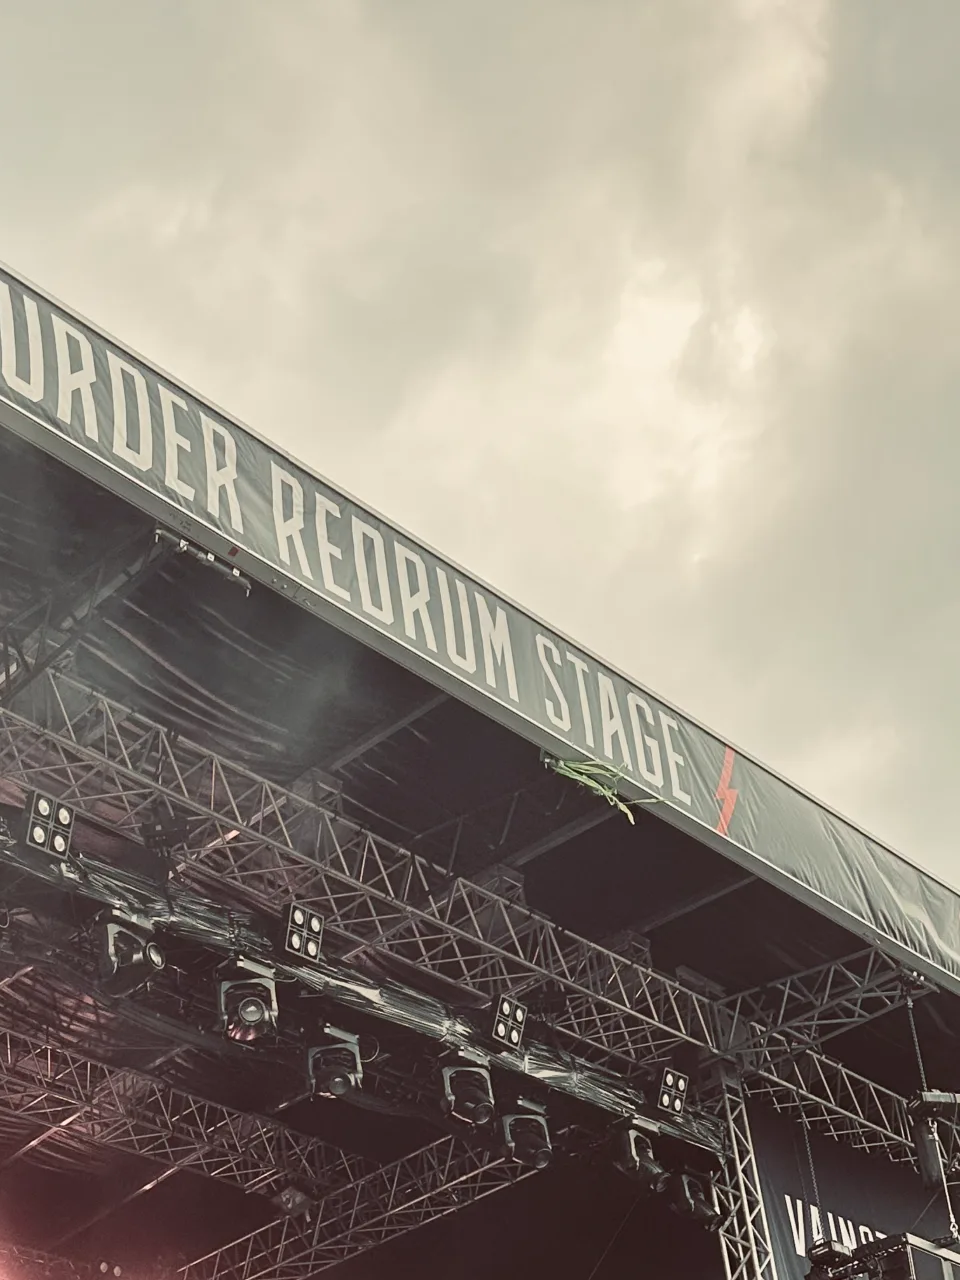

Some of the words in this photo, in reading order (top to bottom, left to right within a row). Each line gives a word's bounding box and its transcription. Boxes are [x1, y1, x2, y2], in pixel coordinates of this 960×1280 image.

[269, 460, 520, 704] REDRUM
[536, 632, 692, 806] STAGE
[784, 1194, 888, 1258] VAIN
